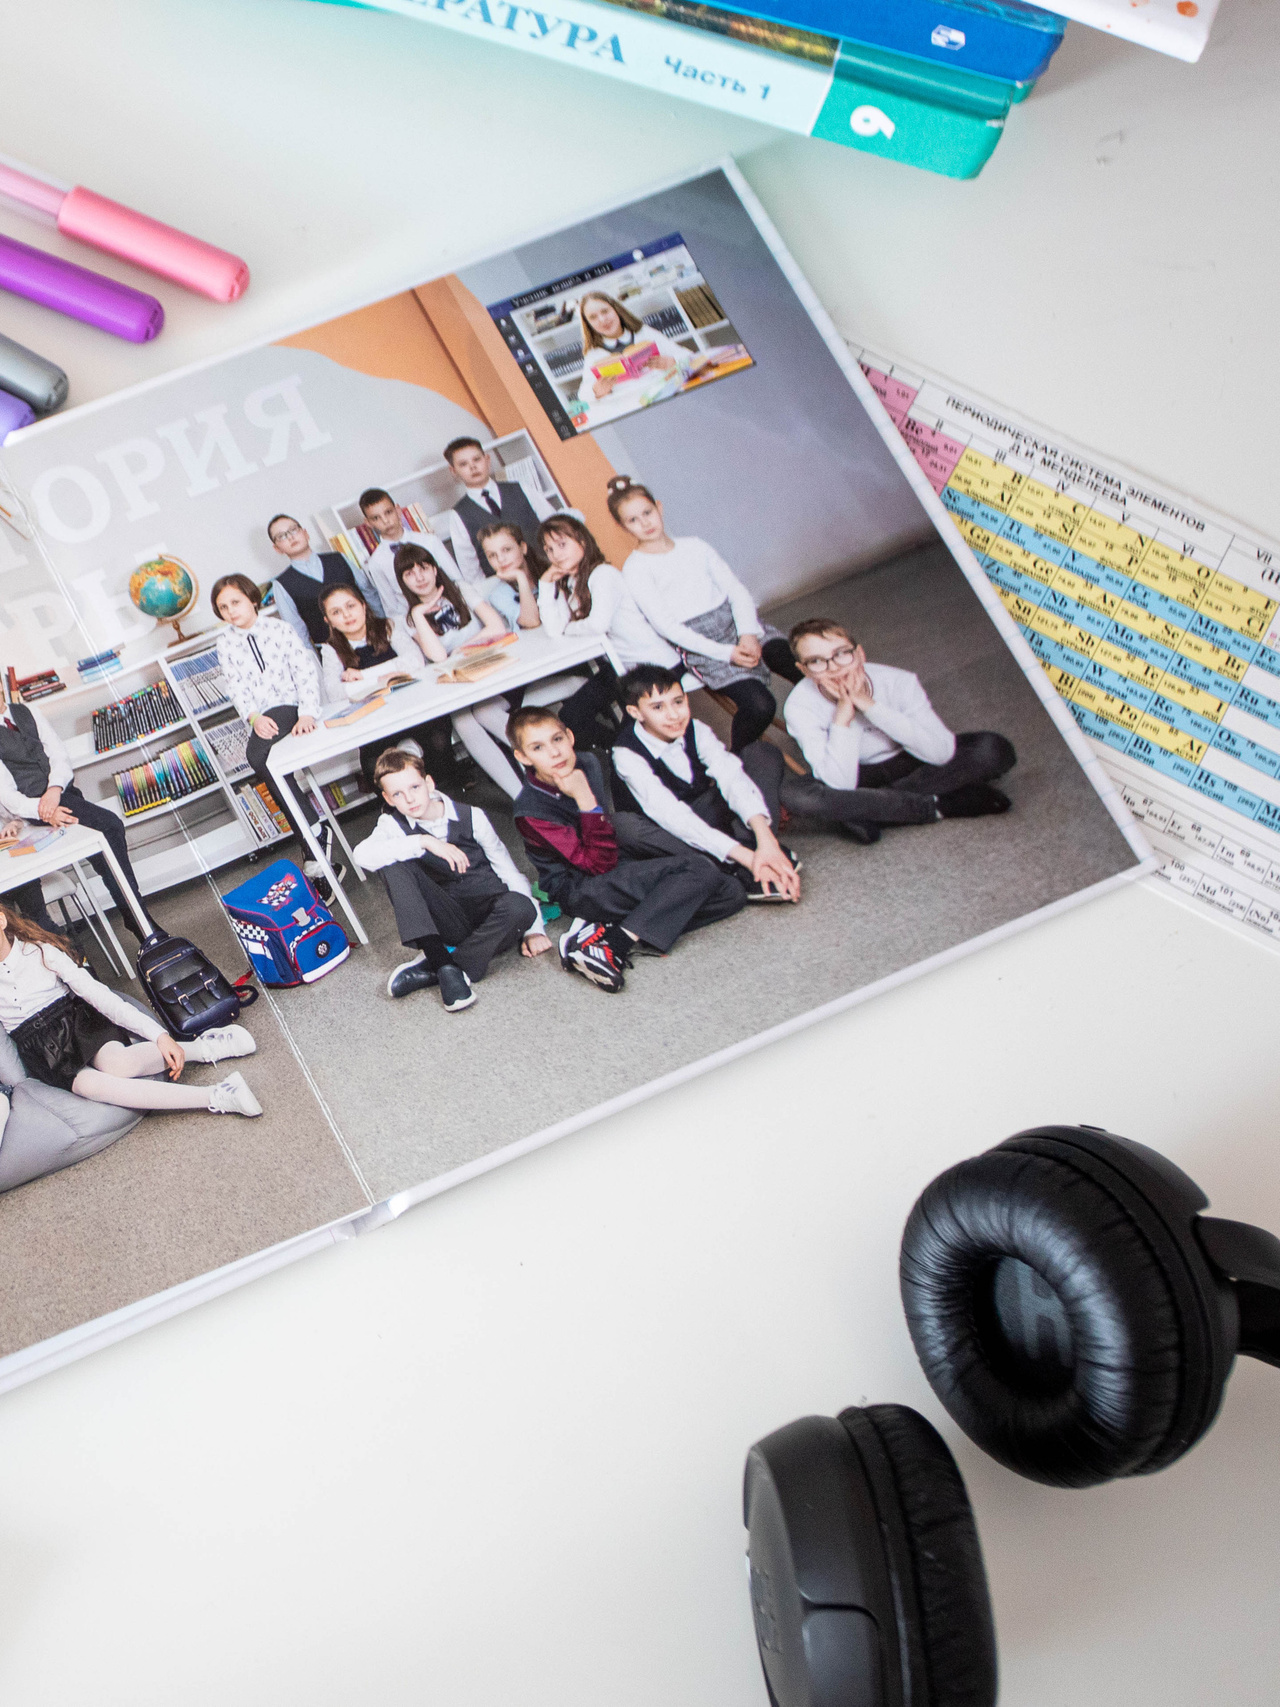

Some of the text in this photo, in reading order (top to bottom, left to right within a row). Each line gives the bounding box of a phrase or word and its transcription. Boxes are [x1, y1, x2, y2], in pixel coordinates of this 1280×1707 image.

[663, 53, 747, 95] Часть
[759, 83, 772, 101] 1
[945, 395, 1058, 458] ПЕРИОДИЧЕСКАЯ
[1061, 451, 1122, 490] СИСТЕМА
[1125, 484, 1206, 533] ЭЛЕМЕНТОВ
[1040, 456, 1127, 507] МЕНДЕЛЕЕВА
